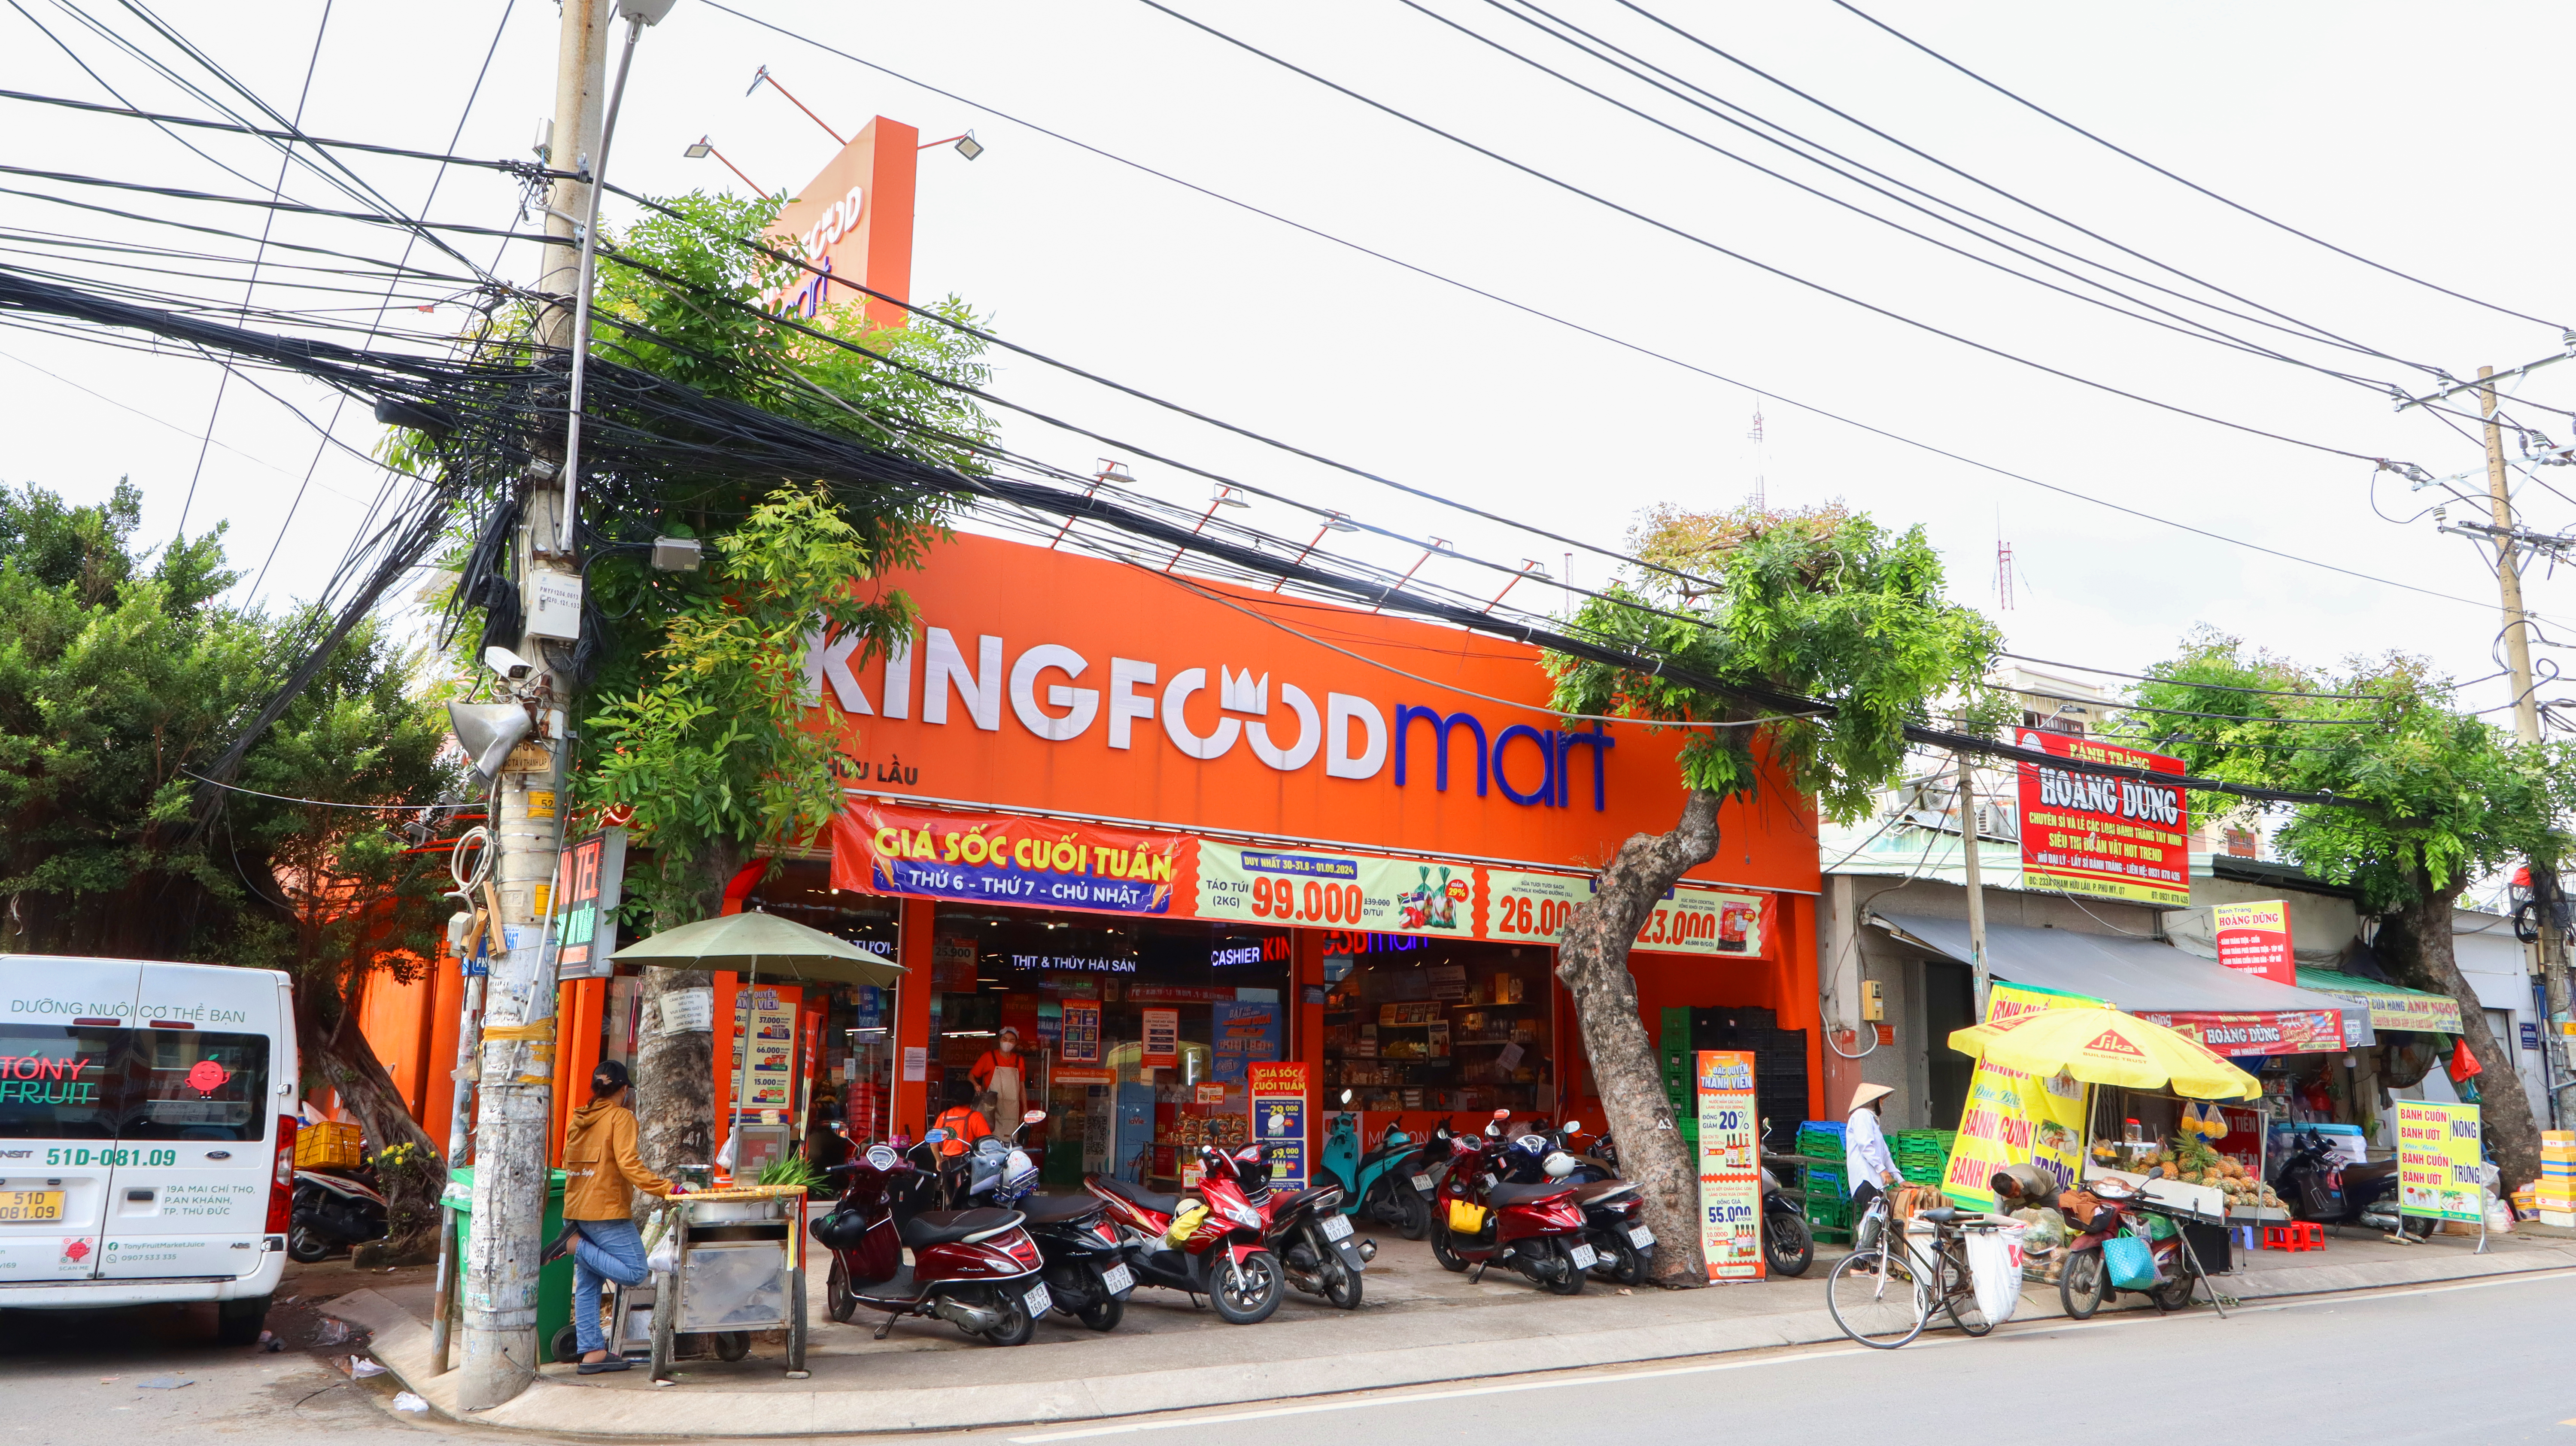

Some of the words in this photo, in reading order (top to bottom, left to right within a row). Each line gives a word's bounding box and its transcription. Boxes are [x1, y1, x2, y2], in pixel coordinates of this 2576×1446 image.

[878, 754, 918, 786] LẦU
[2029, 812, 2057, 827] CHUYÊN
[2067, 815, 2076, 829] VÀ
[2077, 815, 2085, 831] LẺ
[2087, 818, 2099, 832] CÁC
[2101, 822, 2115, 836] LOẠI
[2135, 827, 2155, 841] TRÁNG
[2168, 833, 2182, 847] NINH
[873, 822, 937, 860] GIÁ
[944, 823, 1007, 865] SỐC
[1014, 832, 1086, 873] CUỐI
[1093, 841, 1173, 881] TUẦN
[2049, 831, 2068, 848] SIÊU
[2069, 835, 2082, 854] THỊ
[2108, 839, 2122, 858] VẶT
[2124, 843, 2138, 858] HOT
[2139, 846, 2163, 862] TREND
[1244, 856, 1258, 867] DUY
[1261, 856, 1281, 869] NHẤT
[1282, 860, 1310, 871] 30-31.8
[1316, 863, 1354, 875] 01.09.2024
[2090, 857, 2104, 870] BÁNH
[2105, 860, 2123, 872] TRÁNG
[2127, 863, 2138, 875] LIÊN
[2148, 867, 2160, 878] 0931
[2161, 870, 2170, 880] 878
[908, 869, 949, 889] THỨ
[953, 876, 964, 890] 6
[981, 877, 1022, 896] THỨ
[1024, 881, 1035, 895] 7
[1051, 881, 1089, 901] CHỦ
[1093, 884, 1140, 908] NHẬT
[1206, 878, 1227, 891] TÁO
[1230, 879, 1249, 893] TÚI
[1448, 887, 1466, 897] 29%
[2099, 882, 2108, 893] PHÚ
[1212, 895, 1240, 909] (2KG)
[1252, 876, 1363, 925] 99.000
[1364, 898, 1390, 906] 139.000
[1363, 907, 1383, 917] Đ/TÚI
[2218, 914, 2251, 927] HOÀNG
[2252, 911, 2278, 923] DŨNG
[854, 939, 890, 954] TƯƠI
[935, 947, 971, 959] 25.900
[1012, 954, 1038, 970] THỊT
[1041, 957, 1050, 968] &
[1053, 956, 1086, 969] THỦY
[1088, 958, 1109, 971] HẢI
[1112, 958, 1136, 972] SẢN
[1211, 946, 1260, 967] CASHIER
[754, 987, 777, 999] QUYỀN
[11, 999, 83, 1015] DƯỠNG
[89, 1002, 134, 1017] NUÔI
[140, 1005, 167, 1018] CƠ
[173, 1003, 205, 1021] THỂ
[210, 1010, 246, 1025] BẠN
[758, 999, 779, 1010] VIÊN
[2430, 1002, 2459, 1019] NGỌC
[2206, 1025, 2248, 1044] HOÀNG
[2248, 1024, 2280, 1043] DŨNG
[2091, 1035, 2135, 1053] Sika
[2230, 1048, 2241, 1056] CHI
[2242, 1048, 2260, 1056] NHÁNH
[2083, 1052, 2120, 1060] BUILDING
[1258, 1066, 1277, 1078] GIÁ
[1279, 1066, 1299, 1078] SỐC
[1713, 1064, 1726, 1076] ĐẶC
[1727, 1060, 1749, 1076] QUYỀN
[1253, 1078, 1277, 1091] CUỐI
[1278, 1078, 1306, 1091] TUẦN
[1700, 1074, 1729, 1089] THÀNH
[1730, 1073, 1753, 1090] VIÊN
[0, 1081, 95, 1105] FRUIT
[1719, 1111, 1750, 1130] 20%
[2236, 1113, 2257, 1133] TIỀN
[2400, 1107, 2422, 1121] BÁNH
[2425, 1109, 2447, 1123] CUỐN
[1703, 1121, 1717, 1129] GIẢM
[1962, 1104, 1999, 1140] BÁNH
[1997, 1110, 2032, 1150] CUỐN
[2401, 1125, 2423, 1139] BÁNH
[2425, 1128, 2440, 1141] ƯỚT
[2452, 1118, 2476, 1139] NÓNG
[682, 1130, 702, 1148] 41
[46, 1148, 176, 1167] 51D-081.09
[2402, 1150, 2424, 1165] BÁNH
[2426, 1153, 2448, 1167] CUỐN
[1950, 1152, 1986, 1189] BÁNH
[2403, 1171, 2424, 1184] BÁNH
[2427, 1173, 2442, 1185] ƯỚT
[2454, 1163, 2479, 1184] TRỨNG
[211, 1184, 229, 1193] CHÍ
[232, 1186, 256, 1195] THỌ,
[14, 1193, 45, 1205] 51D
[193, 1194, 233, 1205] KHÁNH,
[0, 1206, 55, 1219] 081.09
[183, 1205, 204, 1215] THỦ
[207, 1206, 230, 1215] ĐỨC
[1708, 1206, 1751, 1223] 55.000
[1326, 1217, 1345, 1230] 59-Z1
[1328, 1224, 1351, 1240] 107.00
[1631, 1227, 1647, 1239] 59-C2
[124, 1242, 205, 1250] TonyFruitMarketJuice
[1634, 1235, 1653, 1248] 657.82
[1574, 1246, 1590, 1258] 70-E1
[1576, 1255, 1596, 1268] 715.70
[1106, 1266, 1126, 1282] 59-S3
[1109, 1276, 1132, 1293] 783.74
[1027, 1286, 1044, 1303] 59-C3
[1031, 1296, 1049, 1314] 160.47
